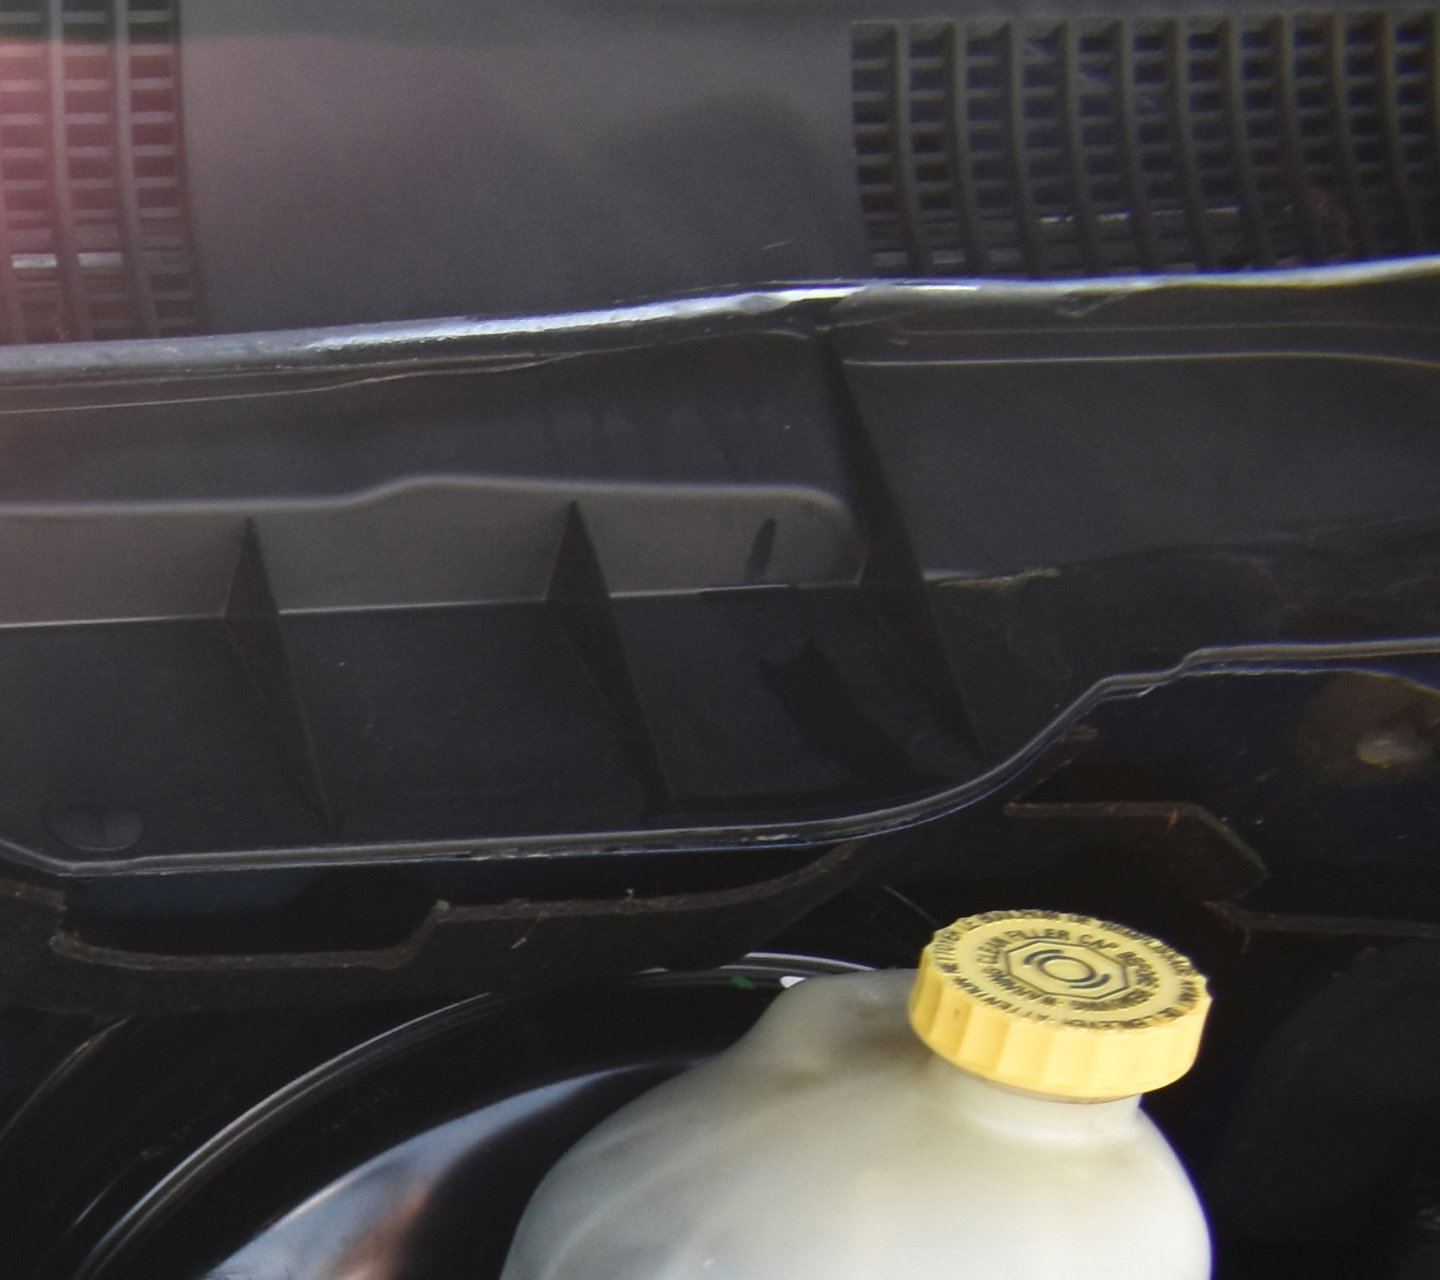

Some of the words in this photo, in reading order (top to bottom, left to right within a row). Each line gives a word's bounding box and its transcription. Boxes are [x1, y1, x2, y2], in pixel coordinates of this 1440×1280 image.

[977, 936, 1006, 965] CLEAN
[1007, 928, 1071, 944] FILLER
[1079, 933, 1118, 951] CAP
